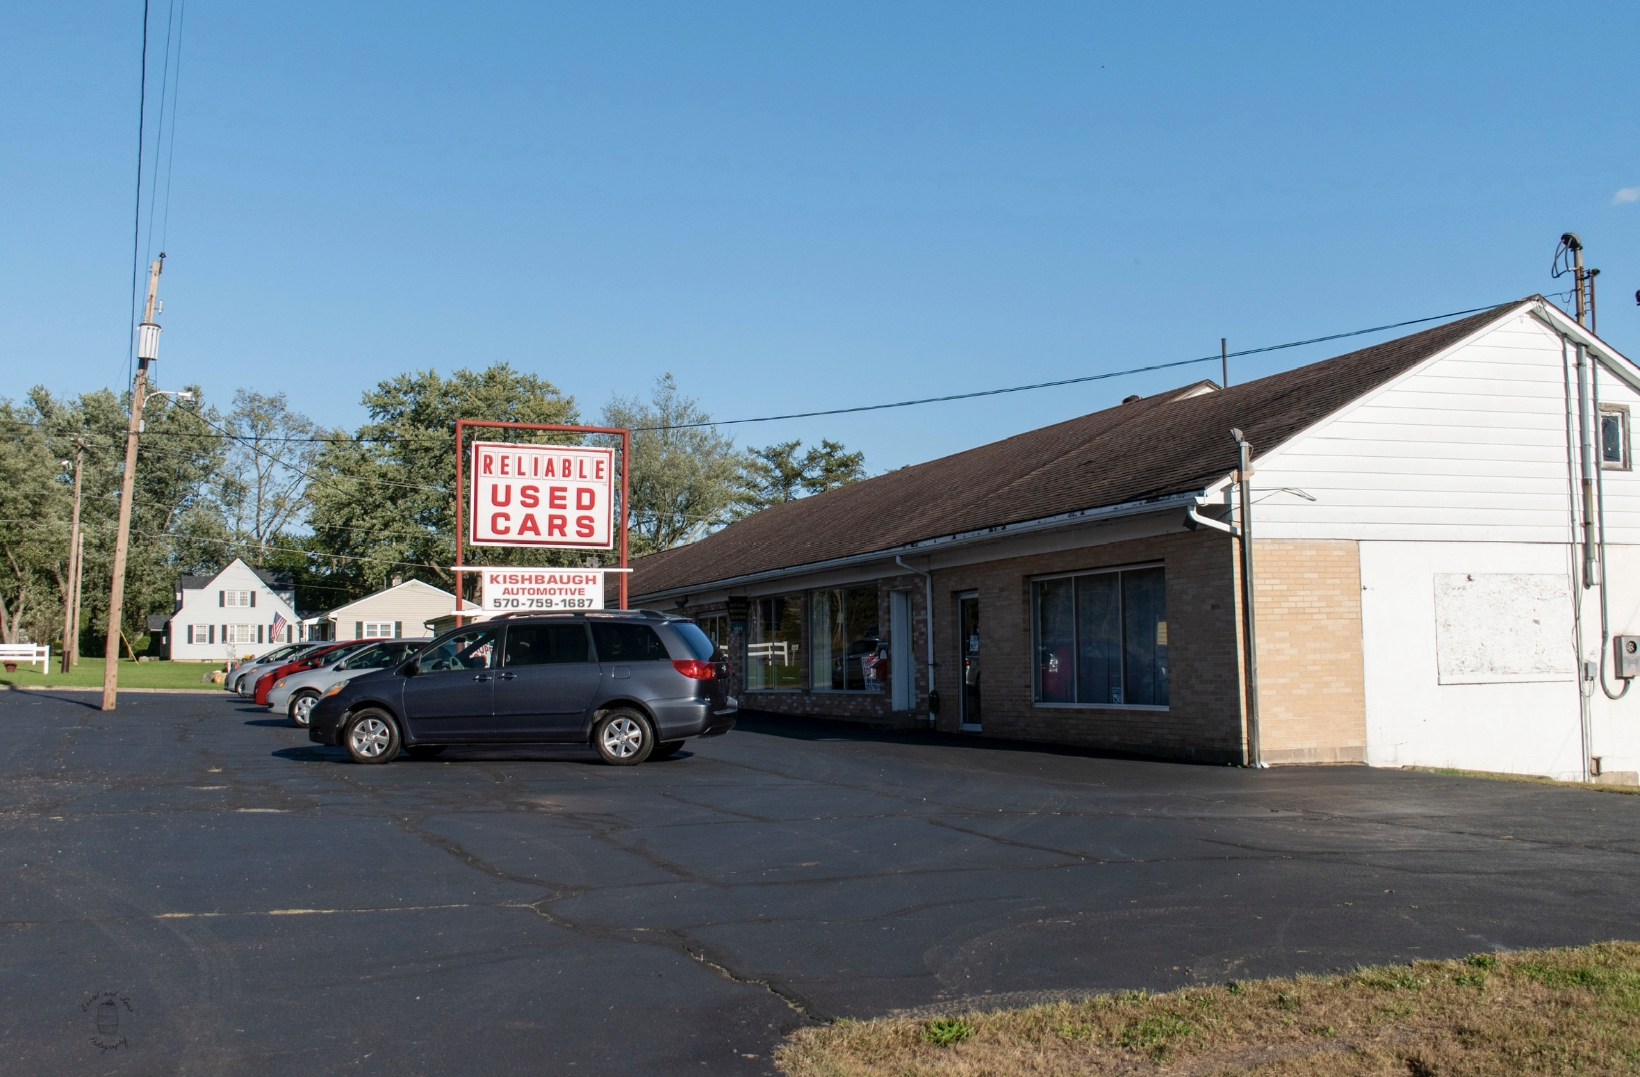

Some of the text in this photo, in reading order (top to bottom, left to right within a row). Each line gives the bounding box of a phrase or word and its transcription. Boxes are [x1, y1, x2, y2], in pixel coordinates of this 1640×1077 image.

[483, 454, 605, 479] RELIABLE
[491, 484, 596, 510] USED
[491, 512, 595, 538] CARS
[489, 574, 597, 585] KISHBAUGH
[502, 587, 586, 596] AUTOMOTIVE
[493, 598, 594, 608] 570-759-1687
